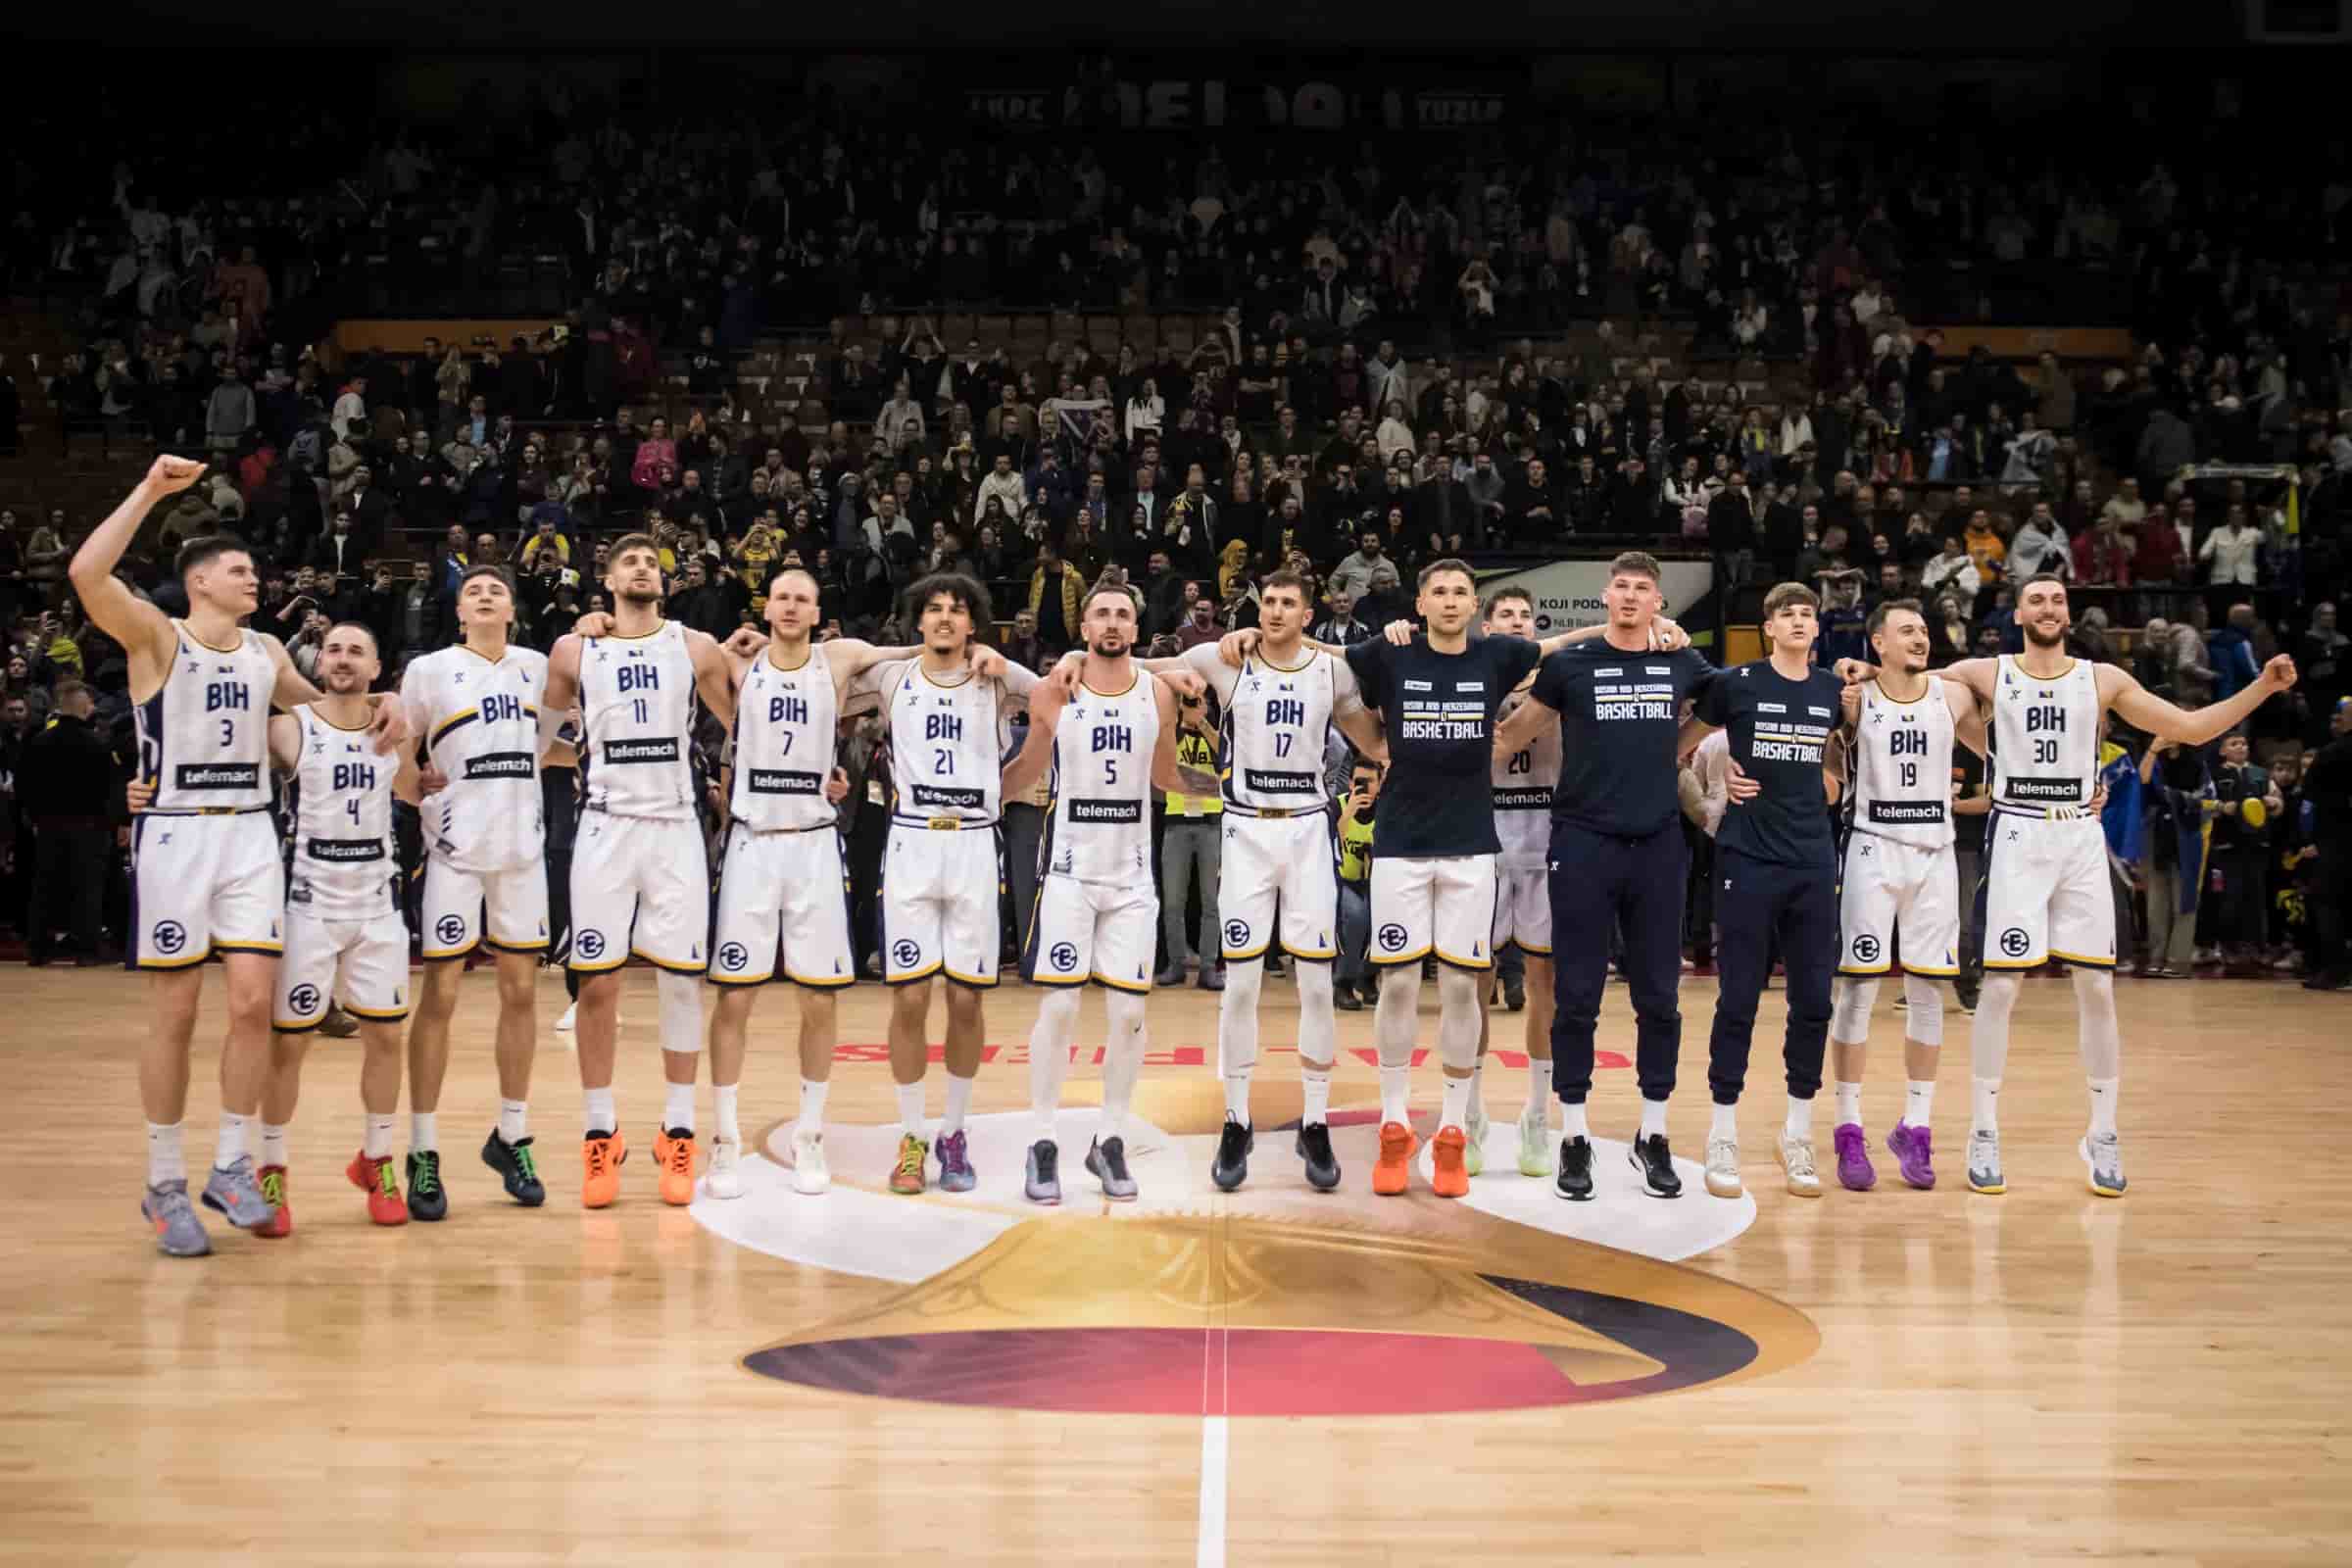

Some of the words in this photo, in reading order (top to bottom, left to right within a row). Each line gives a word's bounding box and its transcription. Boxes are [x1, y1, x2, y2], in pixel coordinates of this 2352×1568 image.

[1540, 599, 1568, 610] KOJI
[617, 664, 659, 692] BIH
[207, 682, 249, 712] BIH
[482, 694, 522, 724] BIH
[633, 699, 648, 723] 11
[769, 697, 808, 724] BIH
[1266, 699, 1304, 727] BIH
[1595, 703, 1674, 720] BASKETBALL
[2027, 706, 2066, 733] BIH
[220, 719, 234, 747] 3
[926, 713, 962, 742] BIH
[1092, 725, 1132, 753] BIH
[1402, 720, 1485, 739] BASKETBALL
[609, 743, 676, 759] telemach
[782, 731, 794, 756] 7
[1275, 733, 1293, 758] 17
[1889, 729, 1928, 756] BIH
[2034, 739, 2058, 763] 30
[934, 749, 954, 775] 21
[1104, 759, 1117, 785] 5
[1508, 750, 1531, 774] 20
[1899, 762, 1917, 787] 19
[333, 763, 375, 791] BIH
[2012, 783, 2079, 796] telemach
[1076, 804, 1138, 817] telemach
[1494, 791, 1551, 805] elemach
[346, 799, 361, 825] 4
[1876, 805, 1941, 818] telemach
